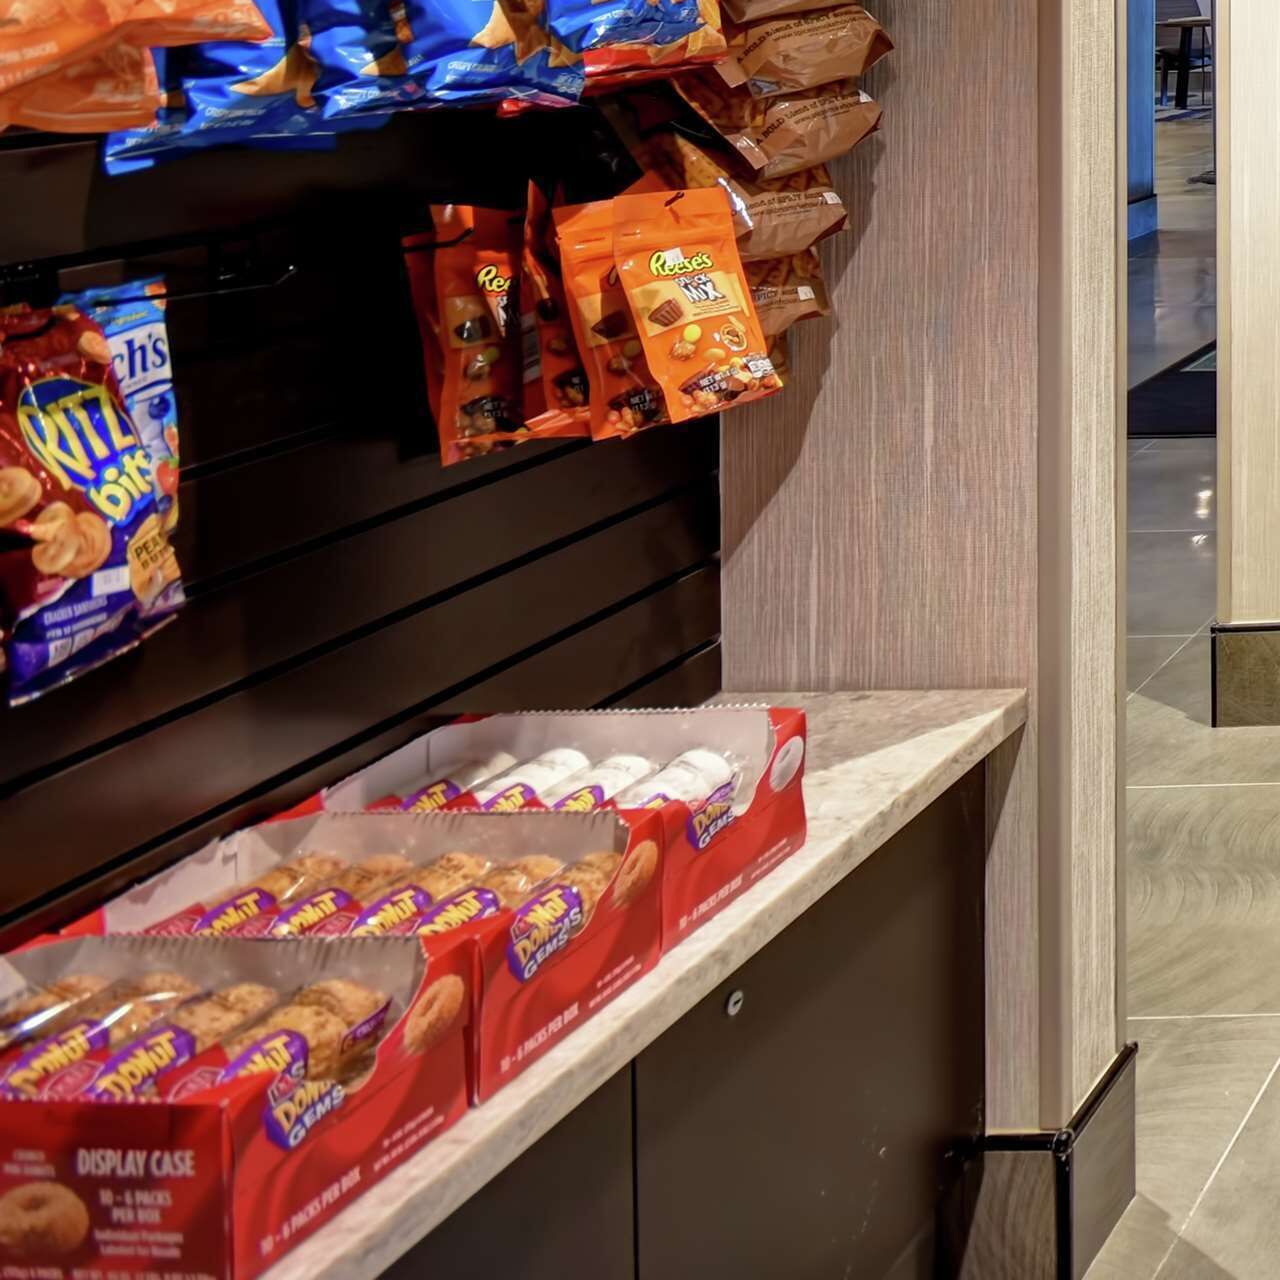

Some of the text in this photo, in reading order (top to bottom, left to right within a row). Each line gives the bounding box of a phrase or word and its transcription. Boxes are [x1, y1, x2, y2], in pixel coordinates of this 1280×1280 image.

[764, 118, 785, 138] BOLD
[20, 385, 137, 491] RITZ
[87, 446, 155, 521] bits
[97, 1032, 177, 1097] DONUT
[289, 1085, 345, 1148] GEMS
[77, 1149, 148, 1177] DISPLAY
[150, 1149, 195, 1177] CASE
[322, 1185, 341, 1209] PER
[341, 1166, 361, 1193] BOX
[112, 1208, 134, 1223] PER
